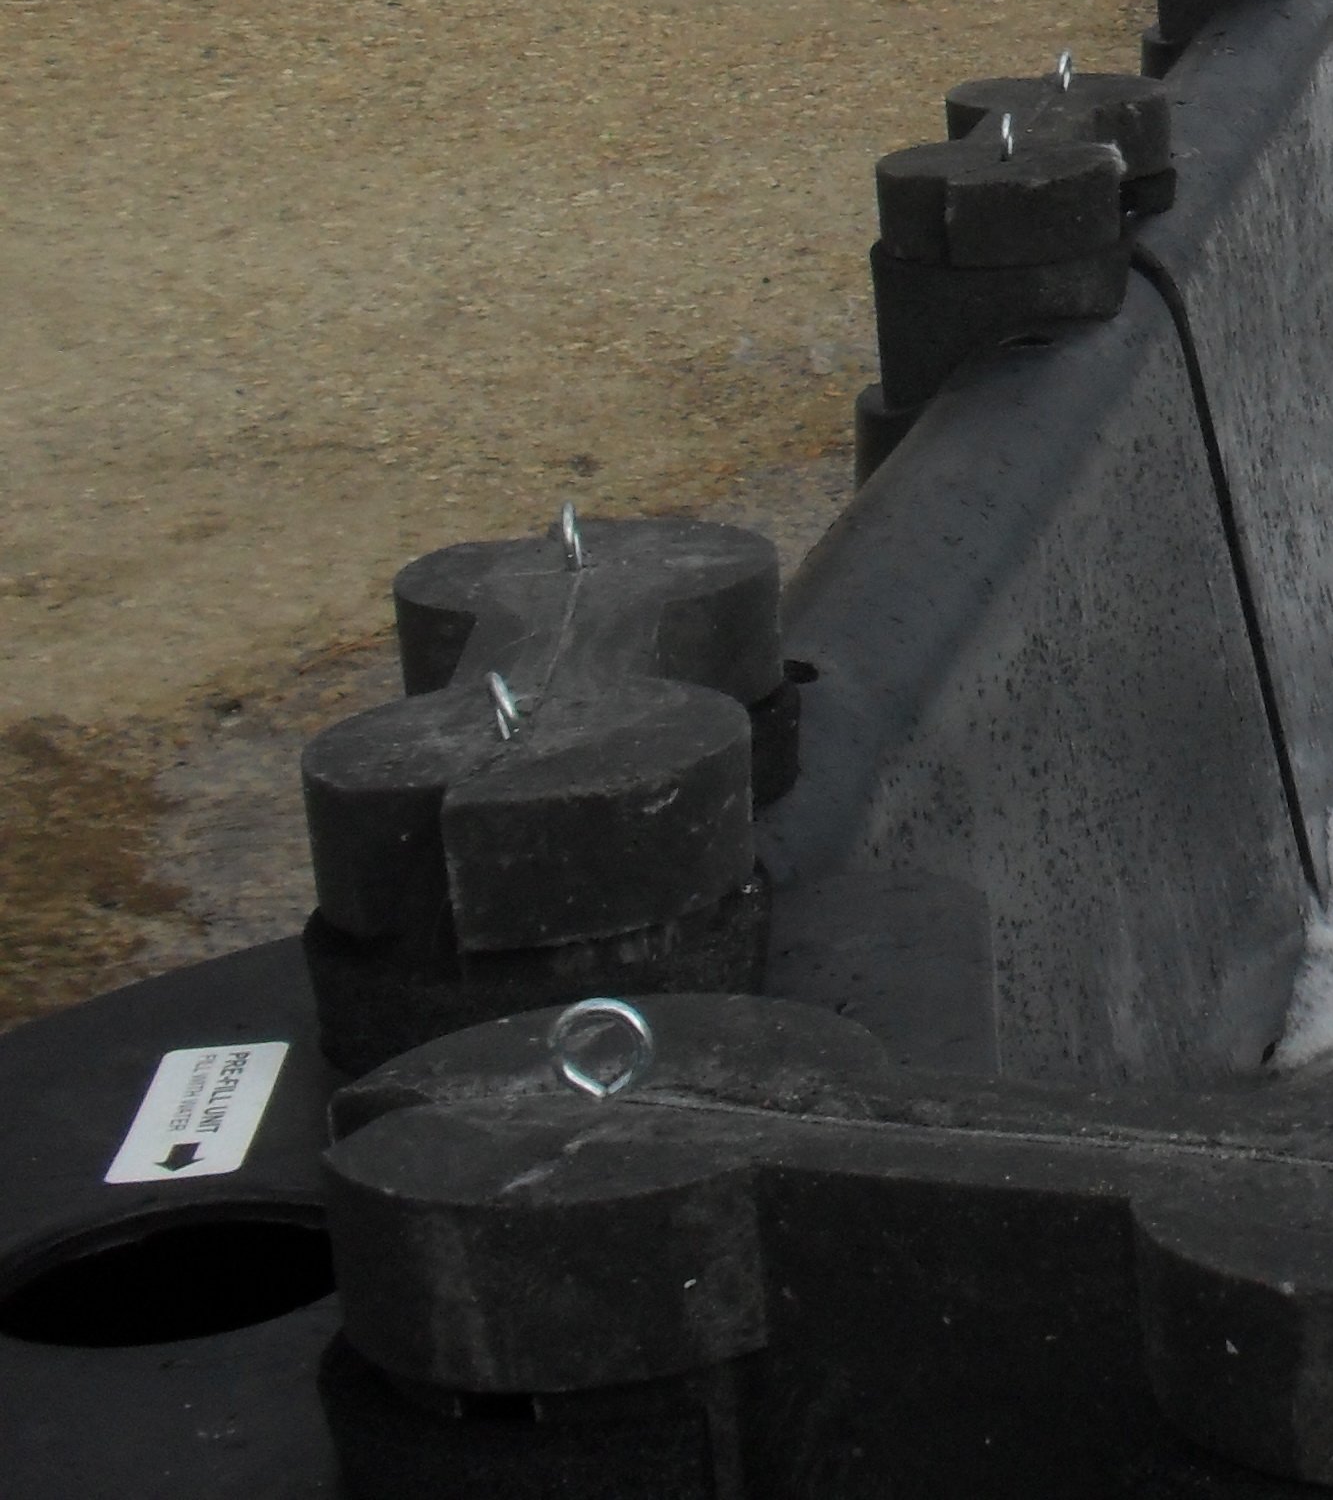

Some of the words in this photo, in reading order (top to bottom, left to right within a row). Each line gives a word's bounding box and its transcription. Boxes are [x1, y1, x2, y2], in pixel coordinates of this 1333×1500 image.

[192, 1053, 217, 1073] FILL
[183, 1074, 208, 1097] WITH
[208, 1051, 251, 1104] PRE-FILL
[166, 1099, 197, 1132] WATER
[195, 1106, 229, 1133] UNIT
